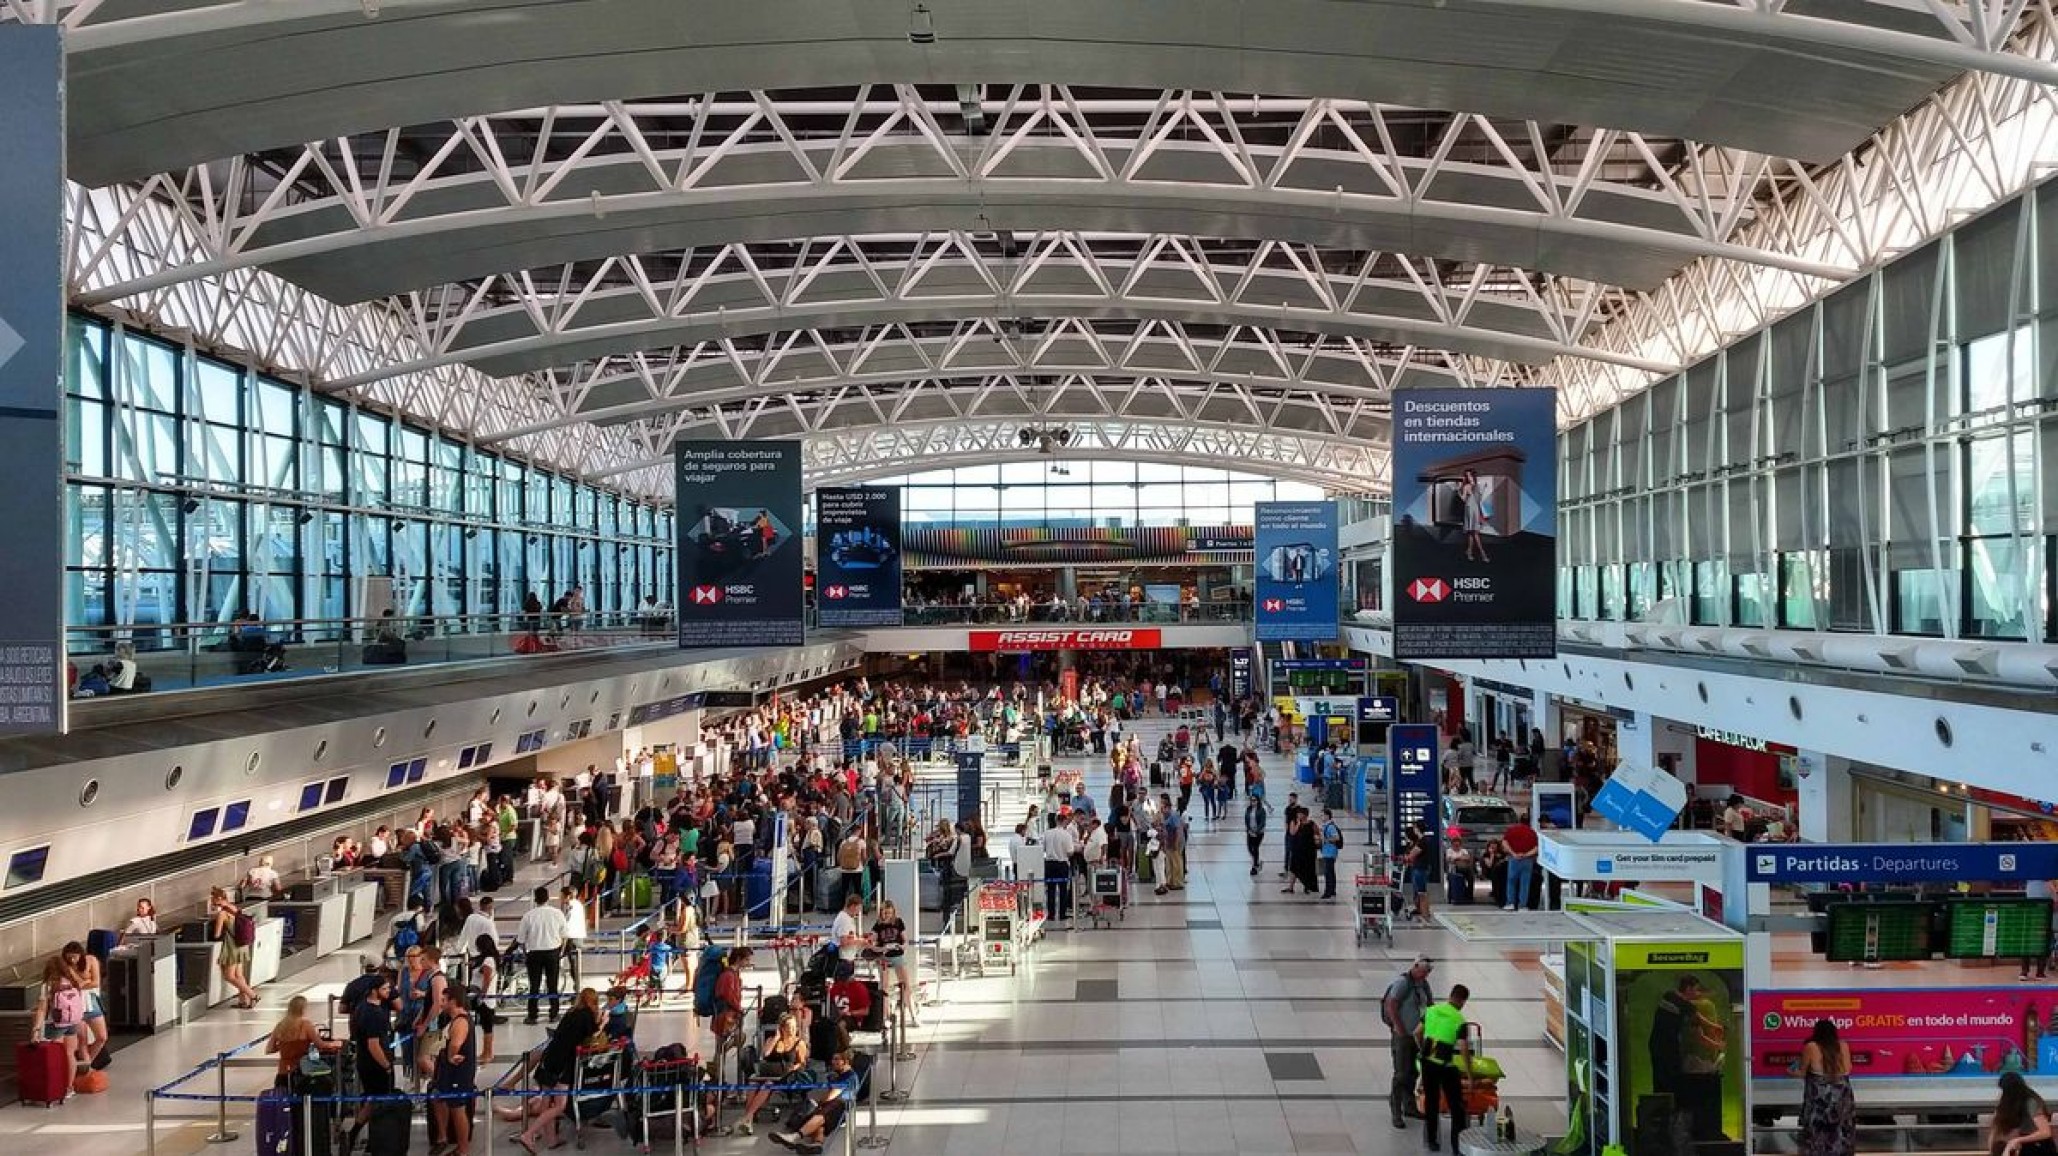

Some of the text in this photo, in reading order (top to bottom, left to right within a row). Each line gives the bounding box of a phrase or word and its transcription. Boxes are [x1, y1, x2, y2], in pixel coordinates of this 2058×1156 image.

[1404, 400, 1491, 413] Descuentos
[1404, 415, 1480, 428] en tiendas
[1404, 430, 1515, 443] internacionales
[684, 450, 783, 462] Amplia cobertura
[684, 461, 776, 473] de seguros para
[685, 473, 716, 484] viajar
[725, 585, 755, 595] HSBC
[1454, 578, 1491, 590] HSBC
[725, 595, 758, 605] Premier
[1454, 592, 1495, 602] Premier
[998, 631, 1133, 643] ASSIST CARD
[1616, 854, 1632, 862] Get
[1633, 855, 1649, 863] your
[1667, 854, 1683, 862] card
[1684, 854, 1716, 863] prepaid
[1785, 856, 1860, 871] Partidas
[1872, 856, 1960, 873] Departures
[1785, 1012, 2014, 1030] WhatApp GRATIS en todo el mundo
